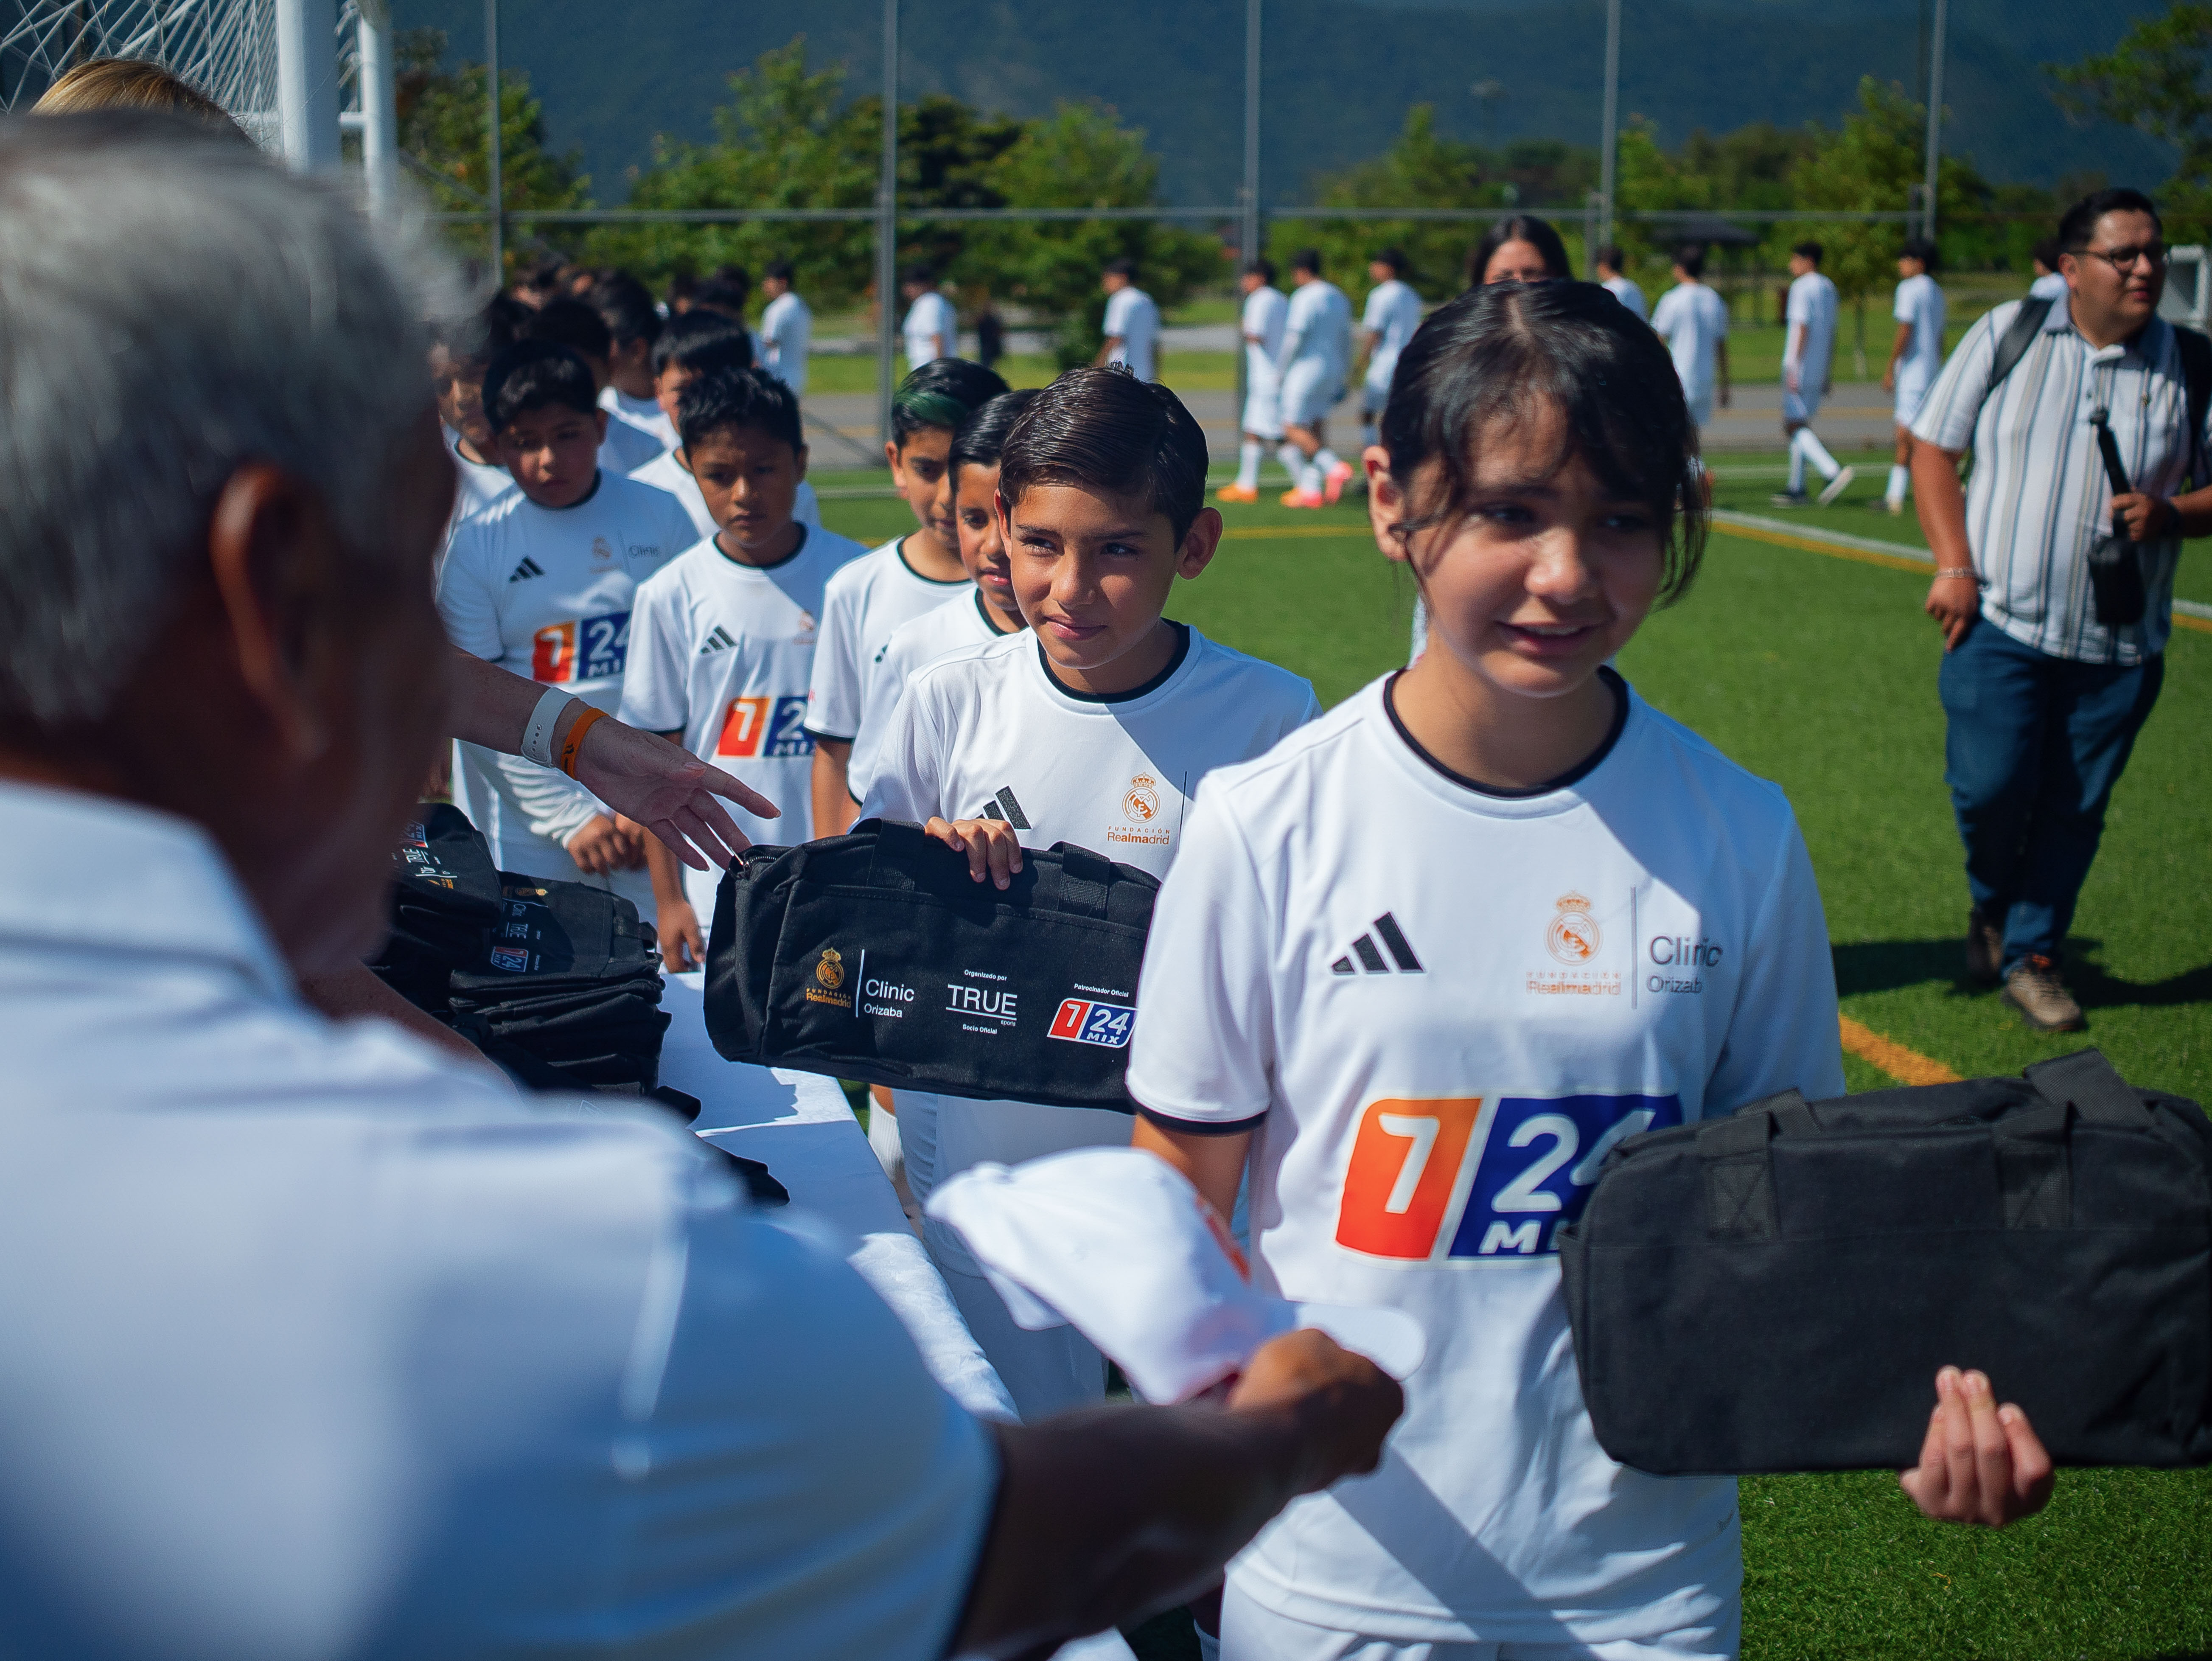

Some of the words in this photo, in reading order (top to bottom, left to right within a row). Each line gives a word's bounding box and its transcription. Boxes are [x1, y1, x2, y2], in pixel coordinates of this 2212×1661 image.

[734, 703, 757, 742] 7
[1108, 826, 1170, 834] FUNDACIÓN
[1107, 832, 1169, 845] Realmadrid
[964, 969, 996, 979] Organizado
[866, 979, 915, 1002] Clinic
[1074, 983, 1110, 994] Patrocinador
[1526, 980, 1621, 995] Realmadrid
[1647, 975, 1702, 993] Orizab
[806, 992, 851, 1008] Realmadrid
[948, 984, 1018, 1016] TRUE
[864, 1003, 903, 1018] Orizaba
[1066, 1003, 1081, 1027] 7
[1089, 1009, 1130, 1035] 24
[962, 1023, 978, 1032] Socio
[979, 1026, 997, 1035] Oficial
[1086, 1032, 1120, 1044] MIX
[1378, 1112, 1441, 1214] 7
